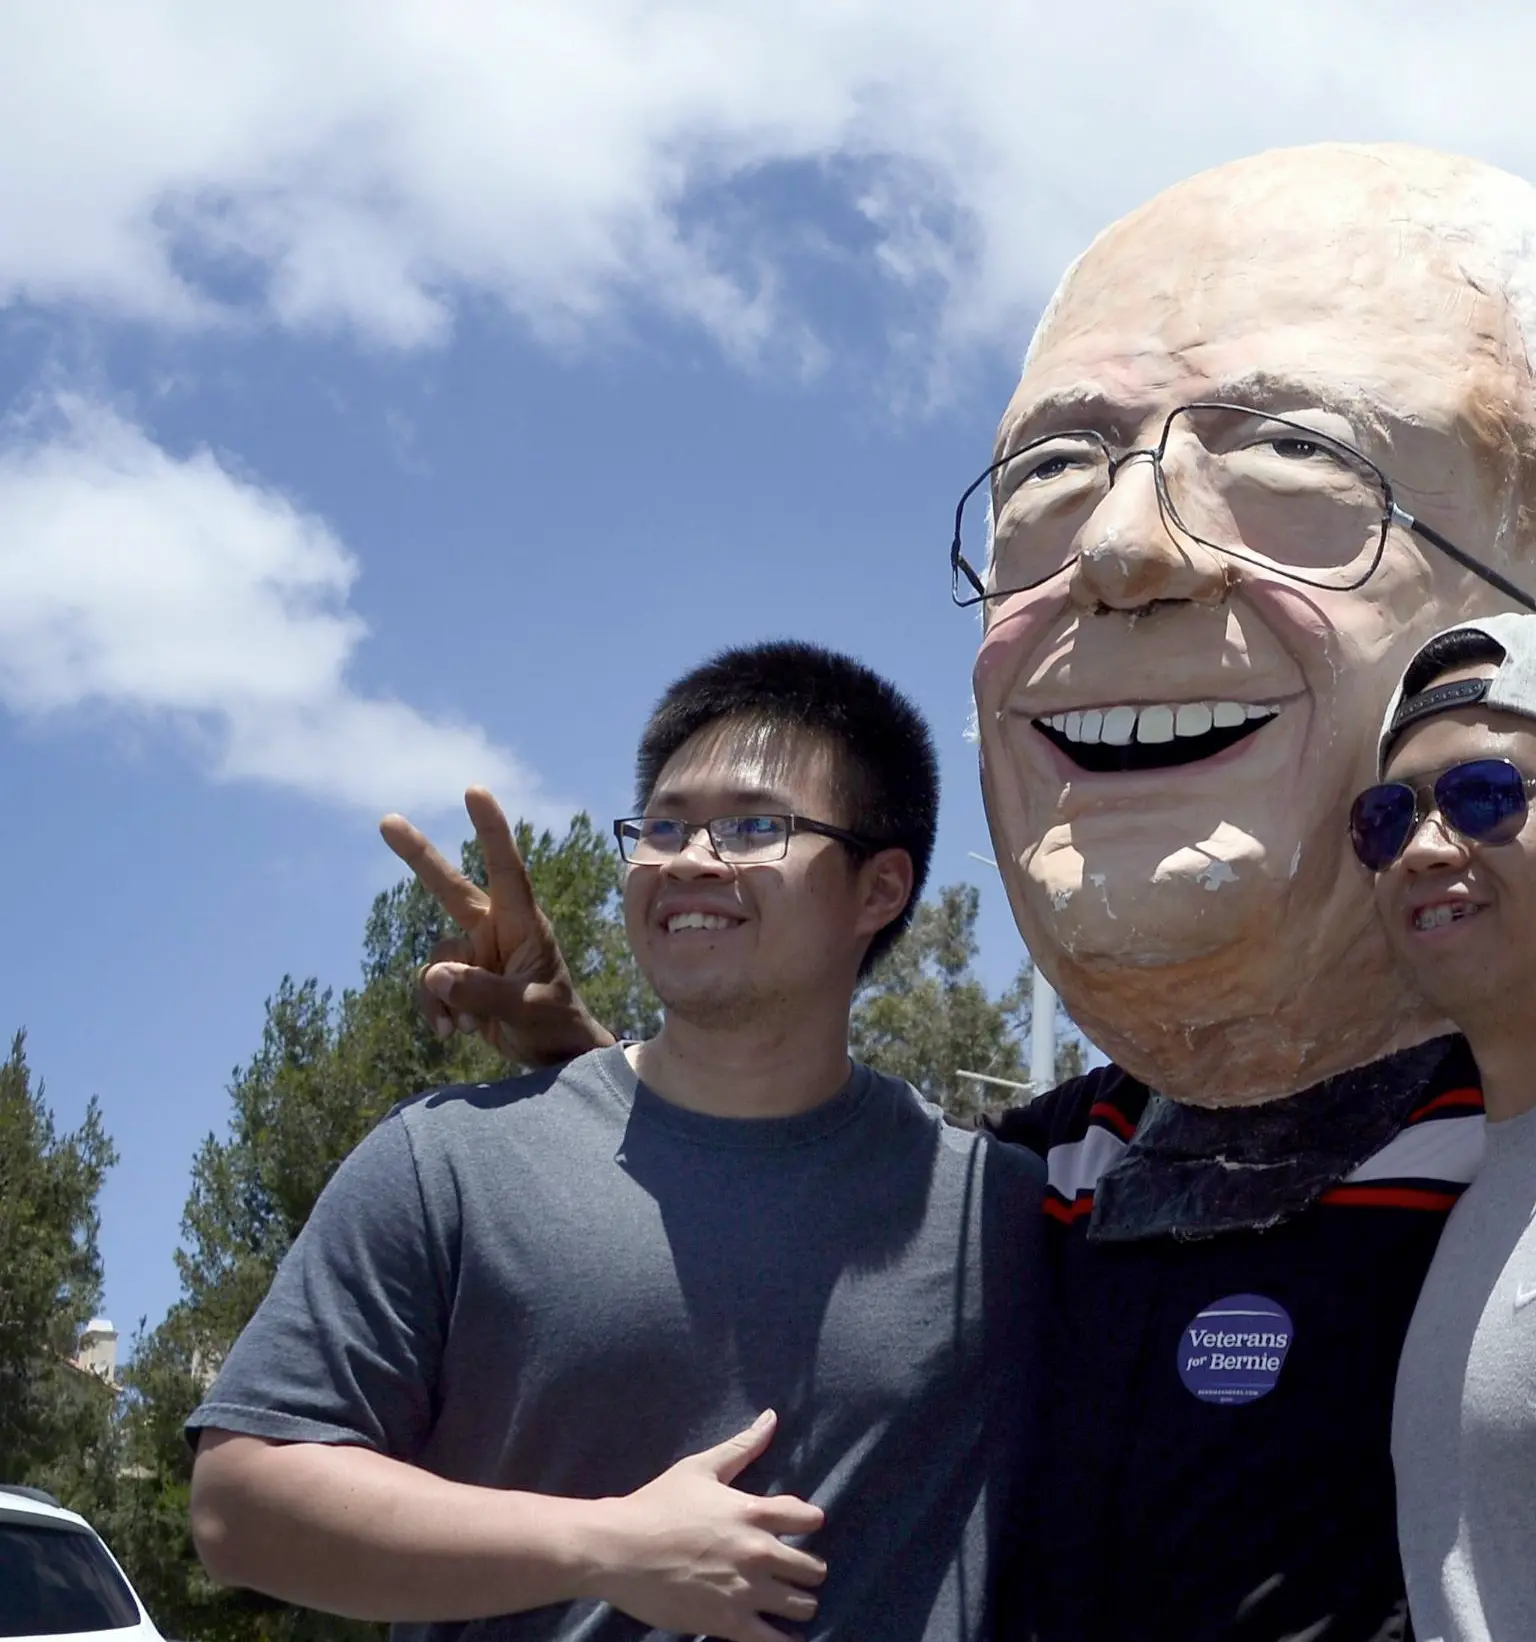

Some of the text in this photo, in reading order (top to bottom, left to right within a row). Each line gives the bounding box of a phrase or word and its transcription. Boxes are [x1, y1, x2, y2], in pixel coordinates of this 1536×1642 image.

[1189, 1329, 1287, 1348] Veterans
[1186, 1352, 1280, 1371] for Bernie
